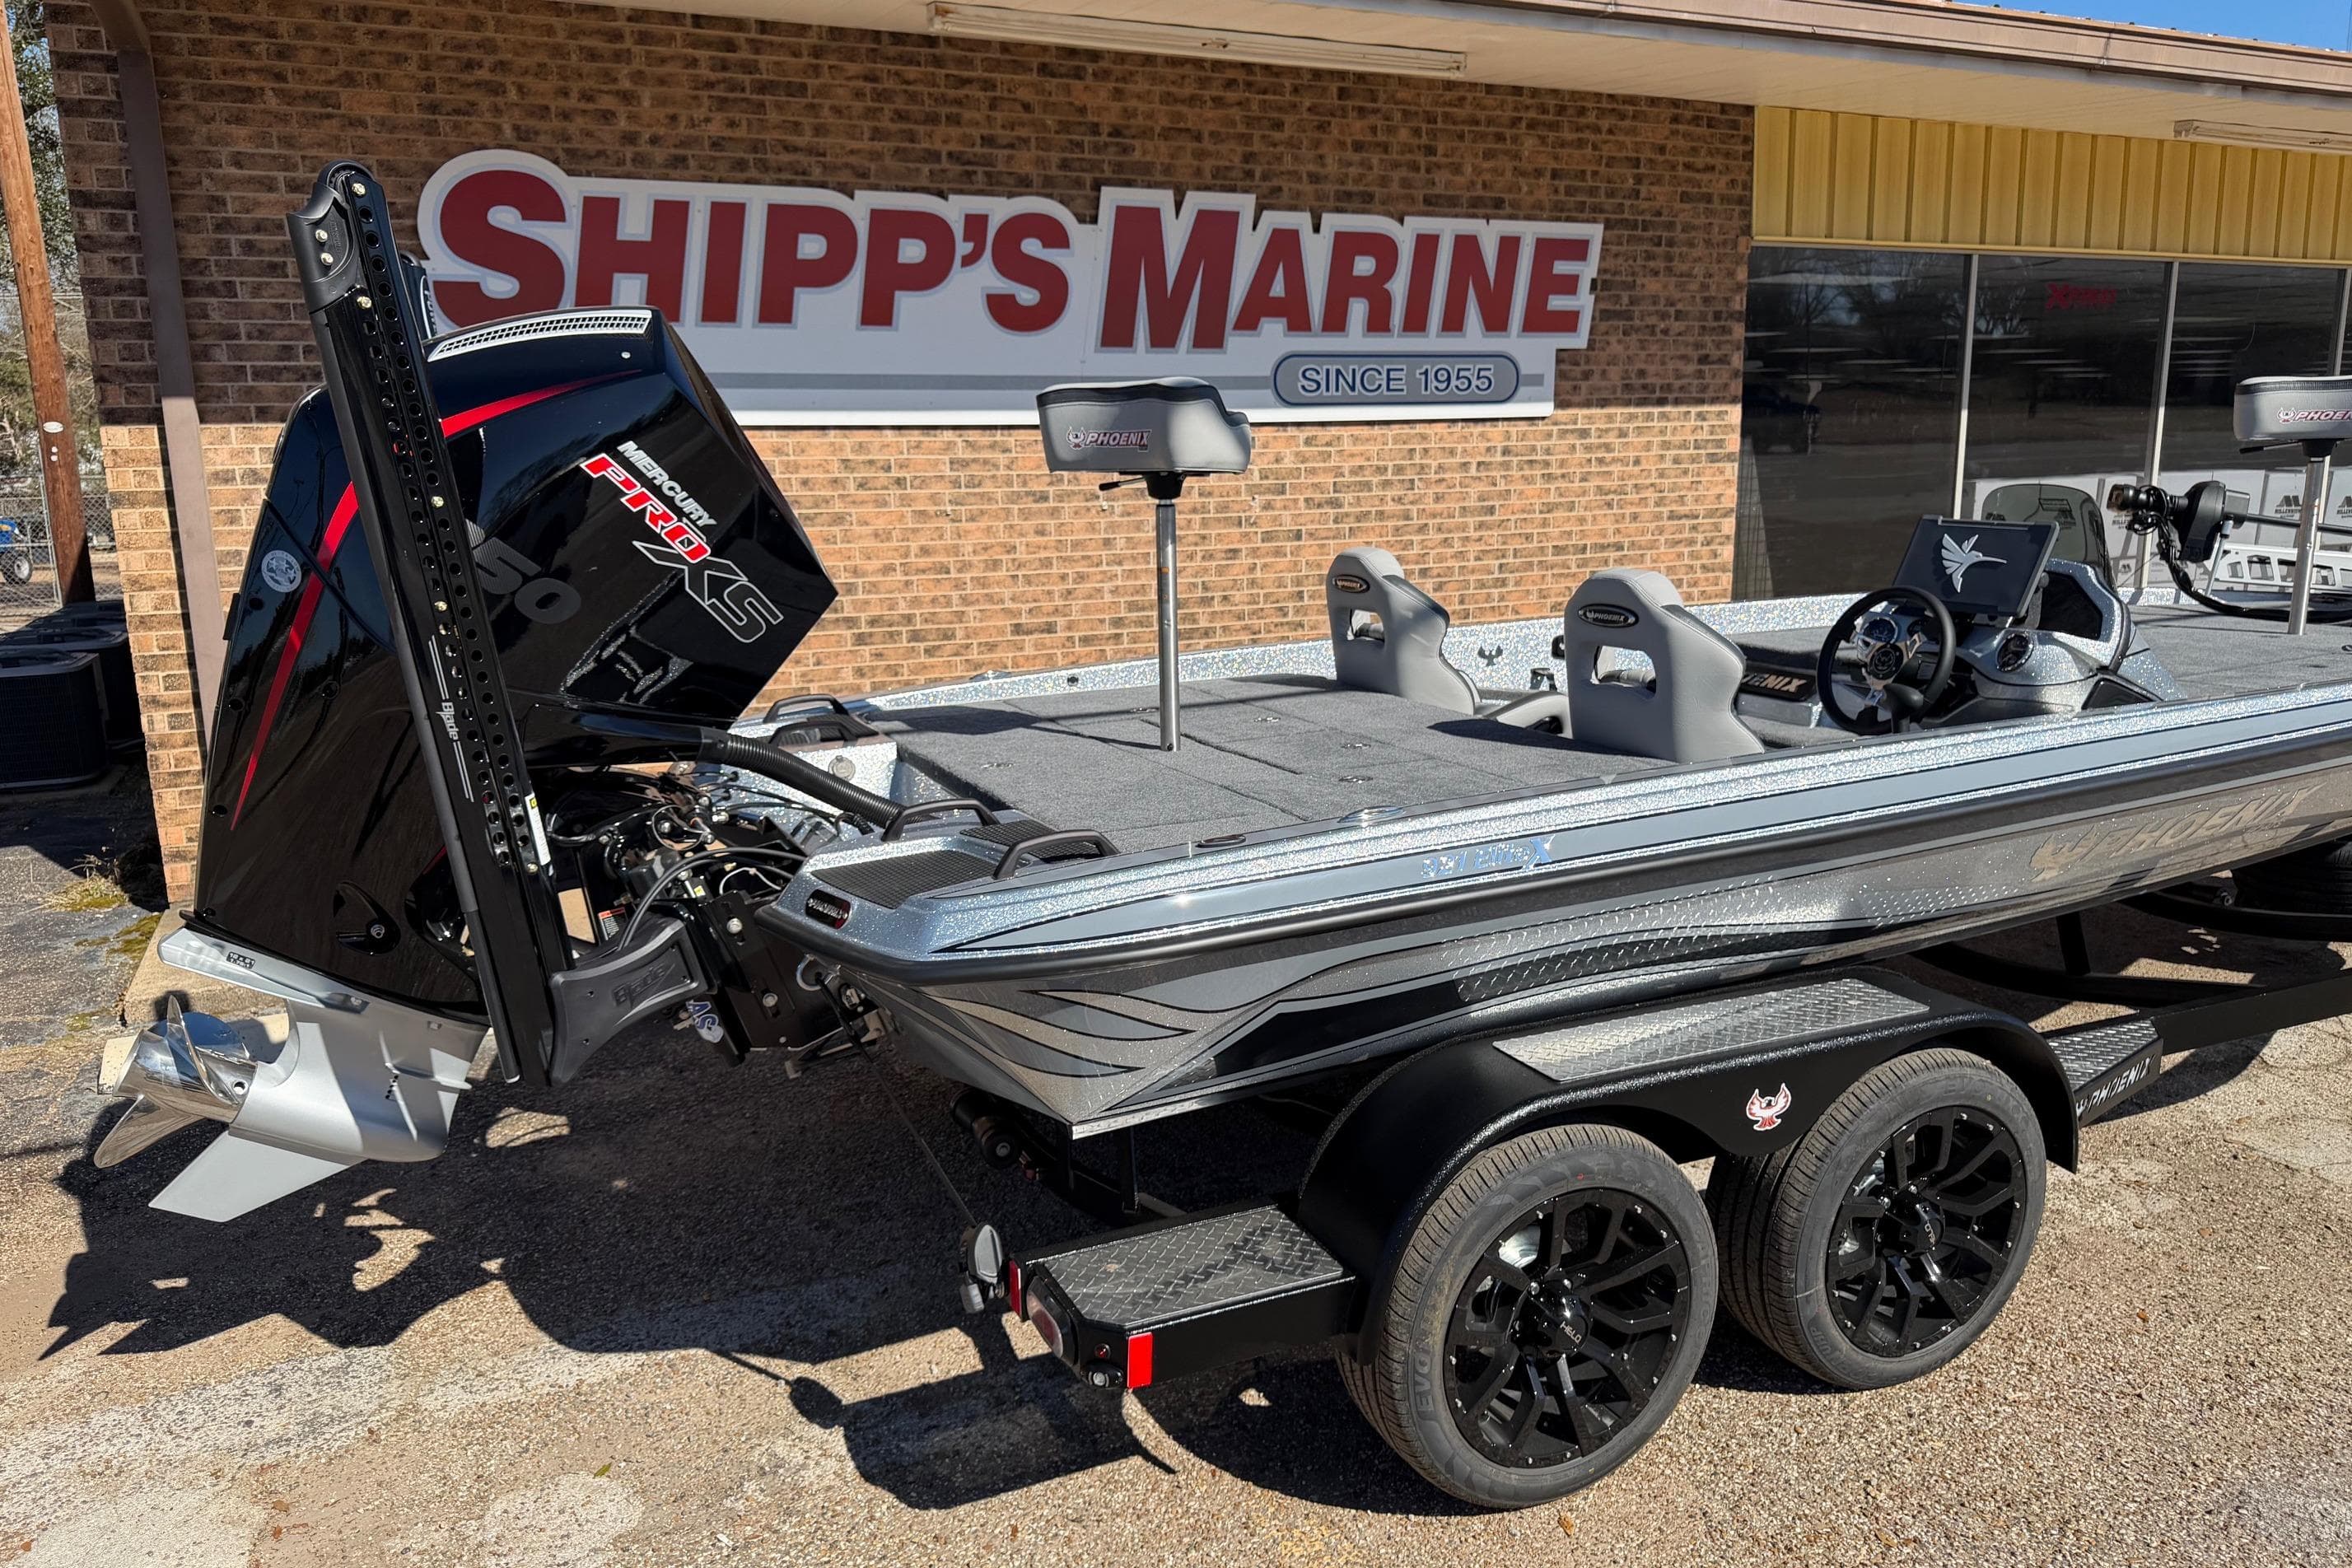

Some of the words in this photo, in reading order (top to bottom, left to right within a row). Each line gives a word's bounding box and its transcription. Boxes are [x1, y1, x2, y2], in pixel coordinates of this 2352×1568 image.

[433, 170, 1071, 334] SHIPP'S
[1099, 204, 1590, 349] MARINE
[1299, 365, 1407, 396] SINCE
[1415, 365, 1495, 395] 1955
[1085, 429, 1152, 448] PHOENIX
[618, 440, 717, 527] MERCURY
[580, 453, 712, 564] PRO
[632, 516, 785, 644] XS
[1740, 674, 1808, 693] ENIX
[436, 702, 460, 741] Blade
[2088, 1055, 2156, 1113] PHOENIX
[1560, 1321, 1581, 1344] HELO
